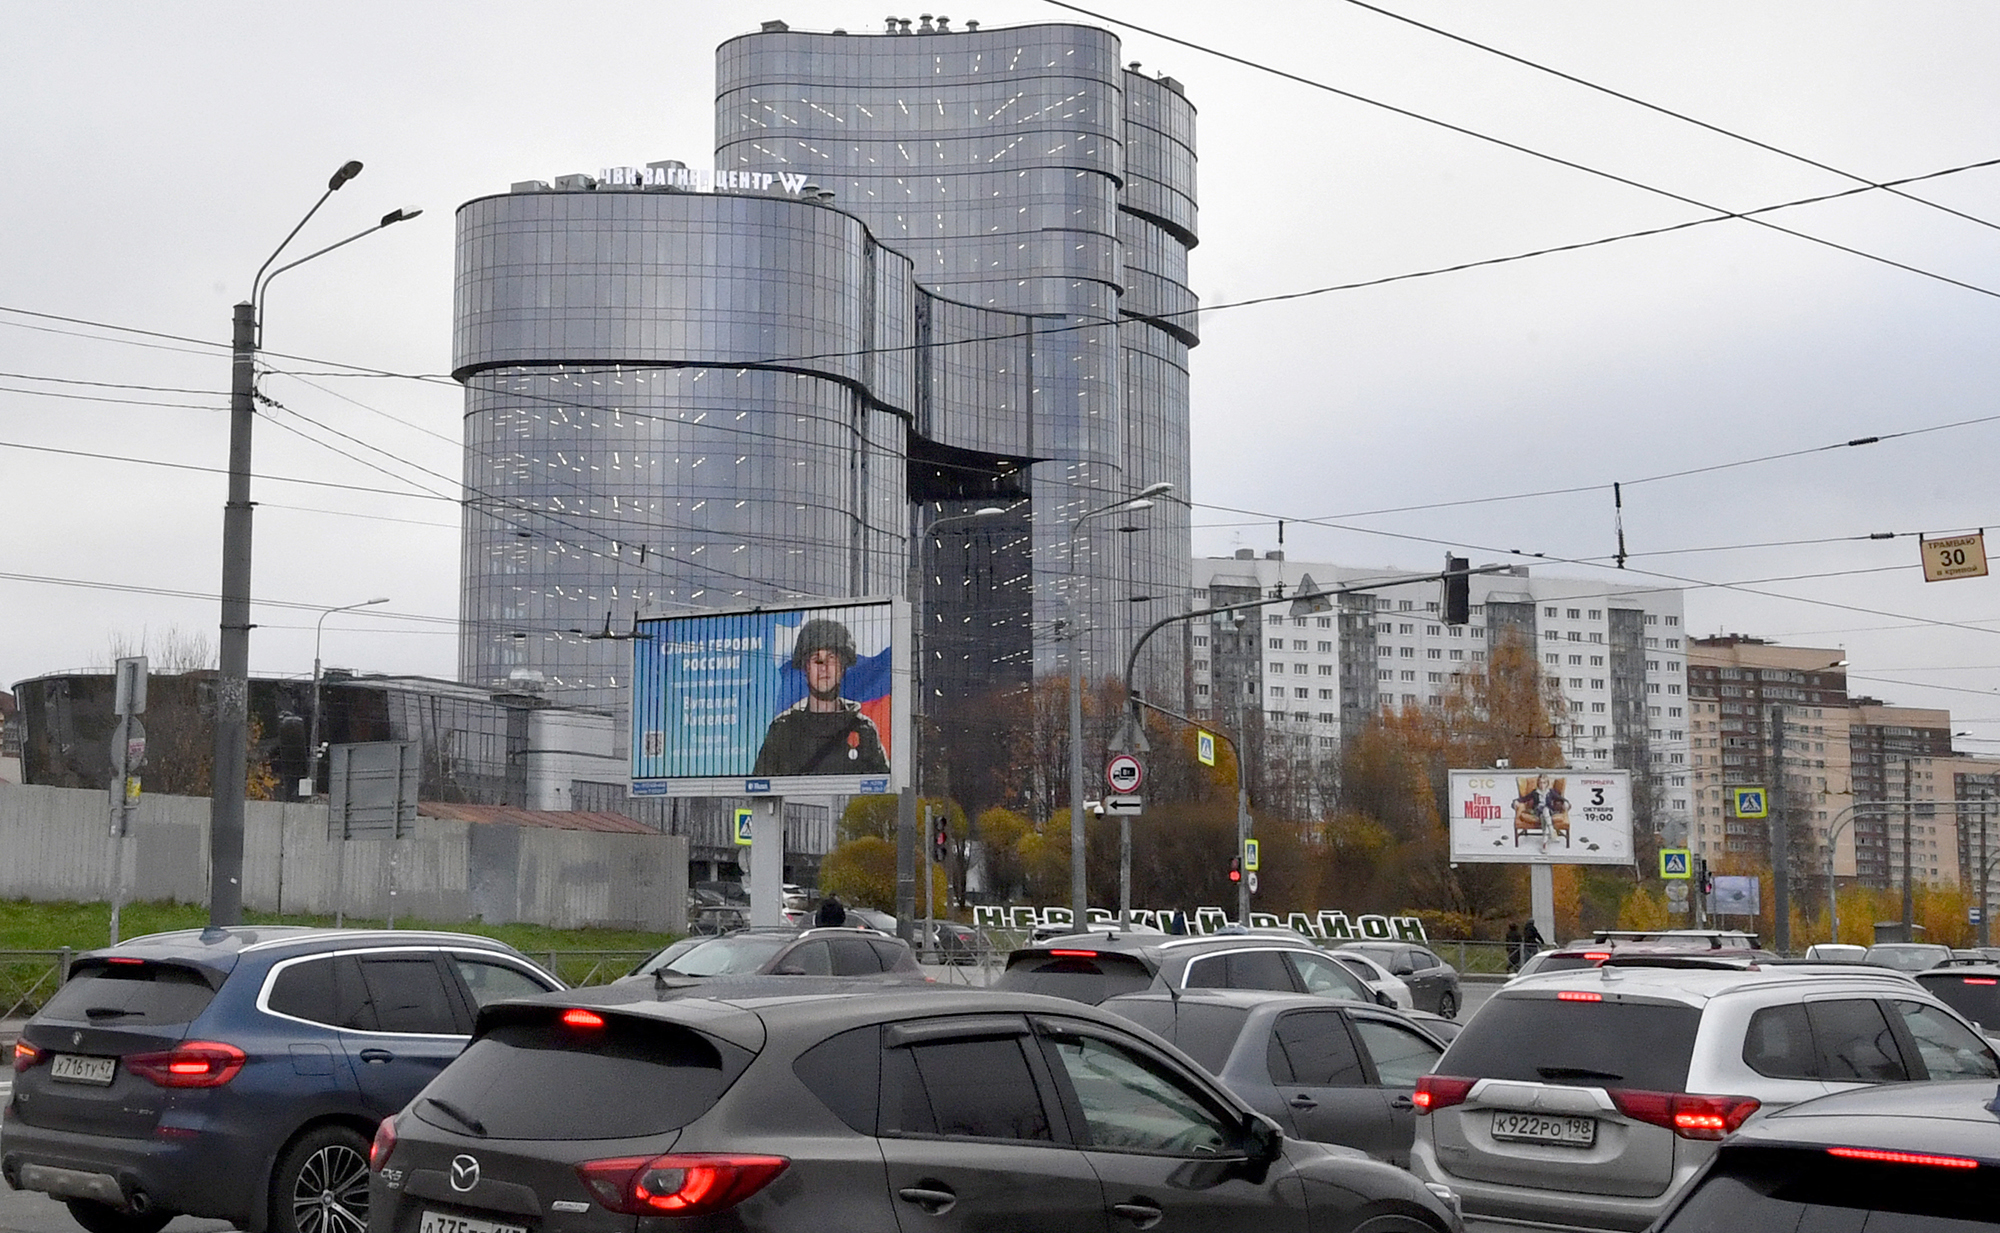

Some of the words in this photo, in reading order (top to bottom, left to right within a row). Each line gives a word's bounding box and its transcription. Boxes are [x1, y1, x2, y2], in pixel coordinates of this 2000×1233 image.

[600, 168, 637, 185] ЧВК
[716, 170, 773, 190] ЦЕНТР
[1928, 538, 1975, 549] ТРАМВАЮ
[1940, 548, 1965, 567] 30
[708, 637, 762, 652] ГЕРОЯМ
[683, 655, 740, 671] РОССИИ!
[1468, 778, 1496, 789] СТС
[1590, 787, 1605, 806] 3
[1464, 800, 1502, 824] Марта
[1585, 813, 1613, 822] 19:00
[1496, 1115, 1561, 1136] К922РО
[1566, 1119, 1590, 1134] 198
